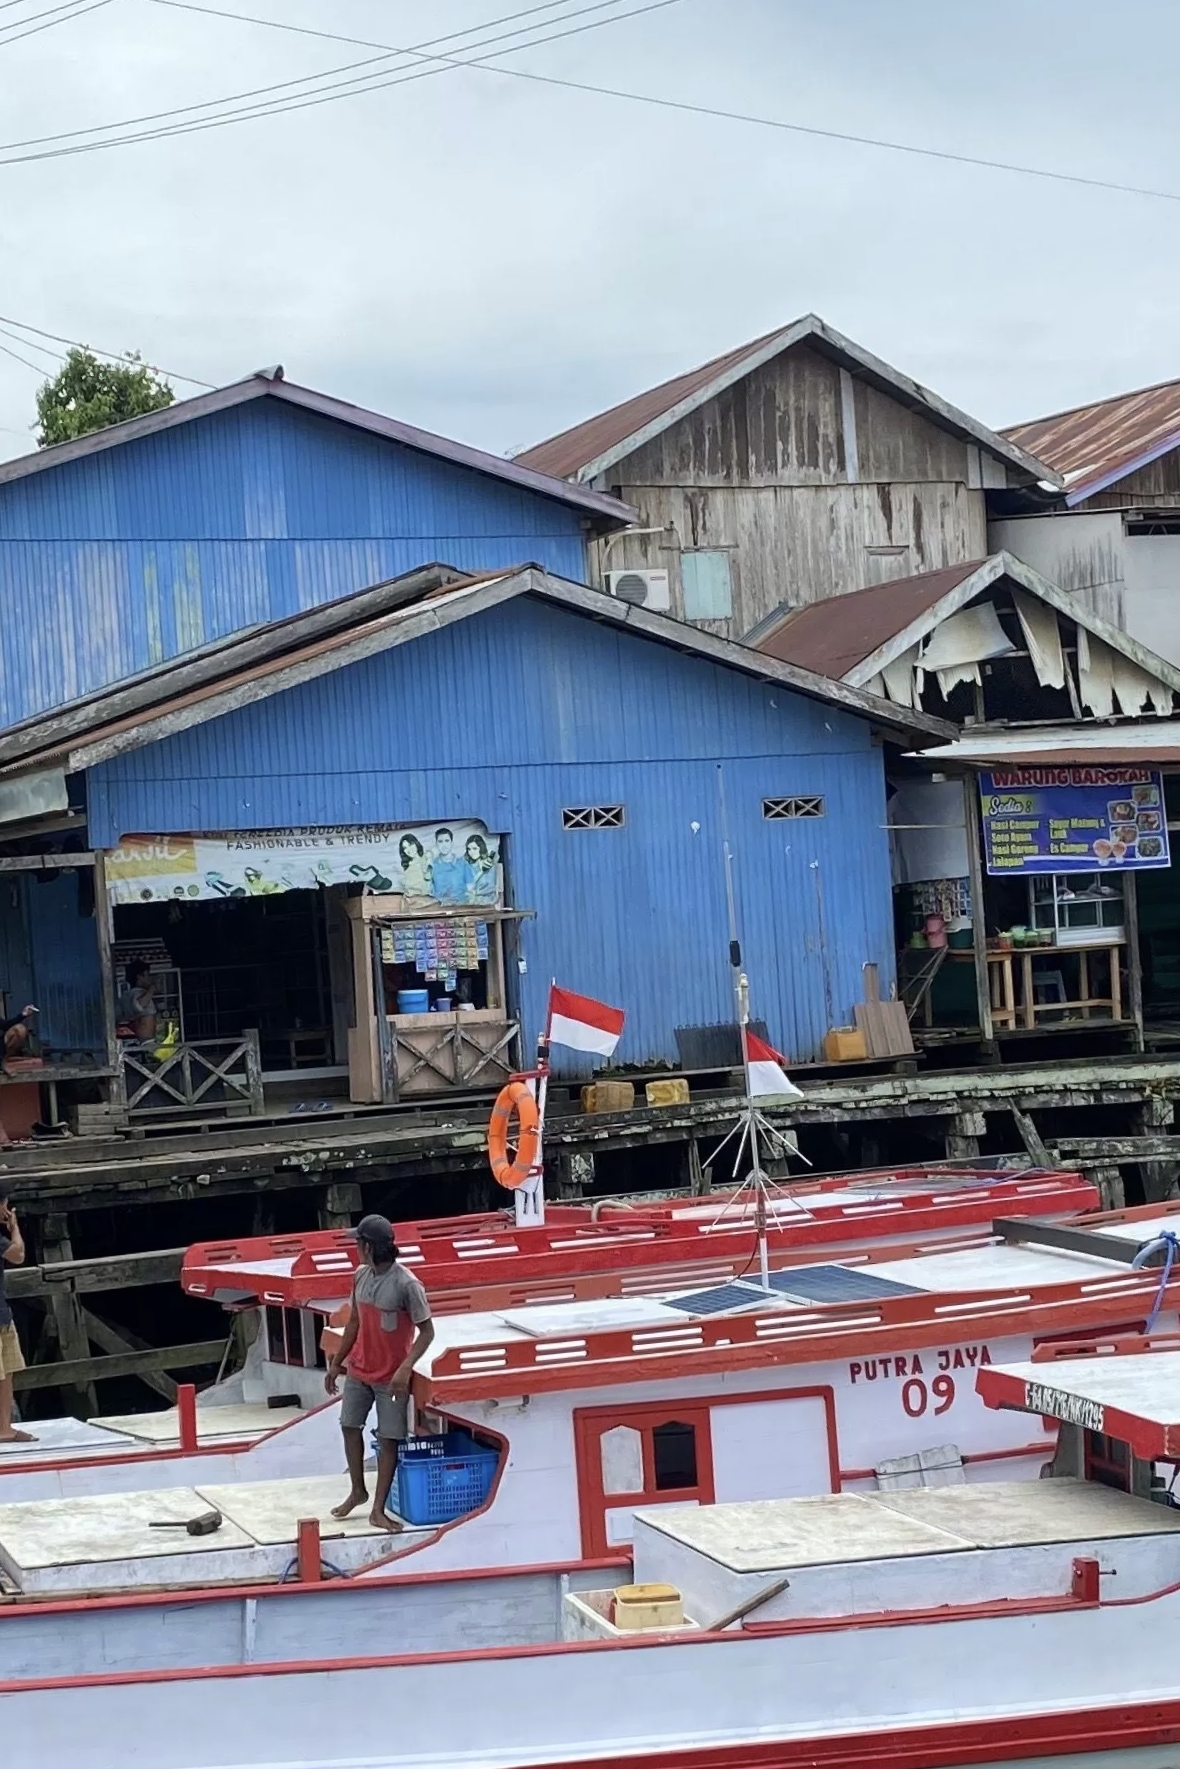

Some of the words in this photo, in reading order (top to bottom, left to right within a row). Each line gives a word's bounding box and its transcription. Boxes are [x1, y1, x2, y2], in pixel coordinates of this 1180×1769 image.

[226, 838, 319, 851] FASHIONABLE
[325, 837, 334, 846] &
[341, 833, 391, 846] TRENDY
[849, 1354, 923, 1384] PUTRA
[937, 1345, 992, 1371] JAYA
[901, 1374, 955, 1418] 09
